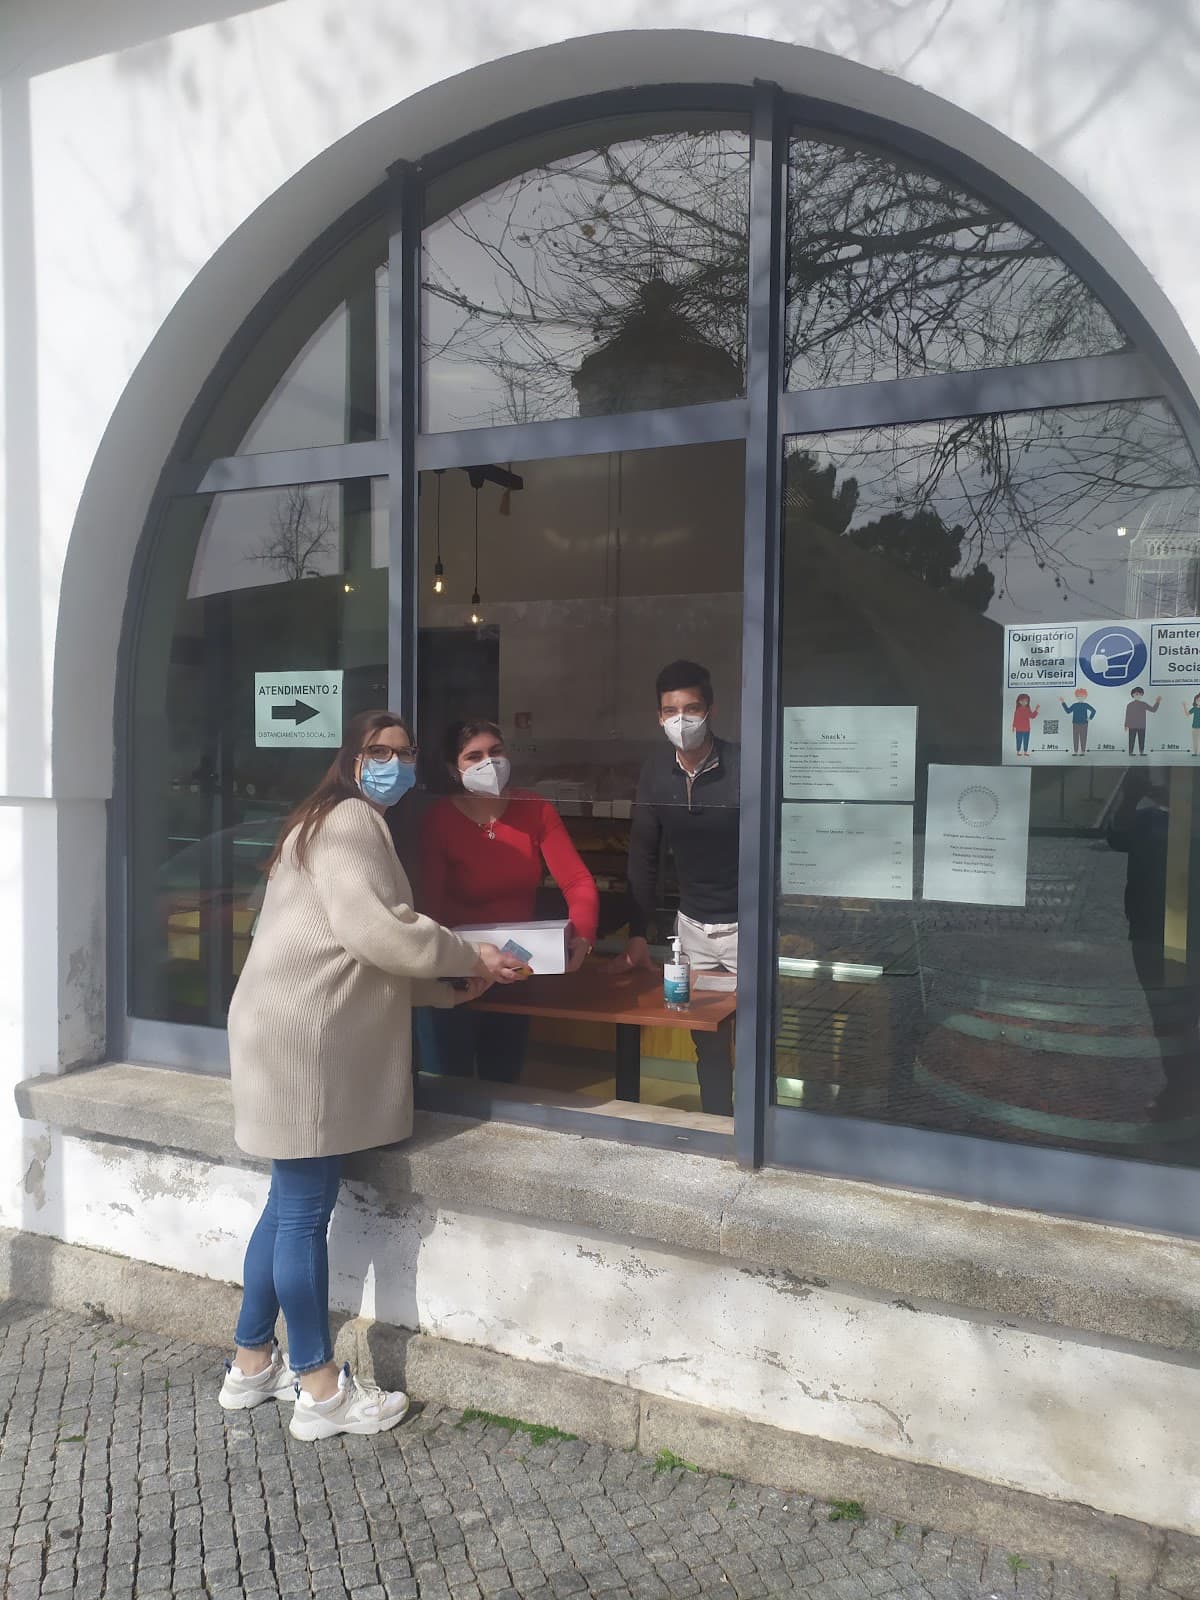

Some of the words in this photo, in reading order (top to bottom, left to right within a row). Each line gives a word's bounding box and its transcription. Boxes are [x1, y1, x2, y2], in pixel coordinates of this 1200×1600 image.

[1012, 631, 1074, 643] Obrigatório
[1030, 646, 1054, 654] usar
[1158, 645, 1200, 656] Distân
[1019, 657, 1065, 667] Máscara
[1010, 671, 1033, 680] e/ou
[1036, 669, 1074, 679] Viseira
[258, 685, 330, 696] ATENDIMENTO
[332, 684, 338, 695] 2
